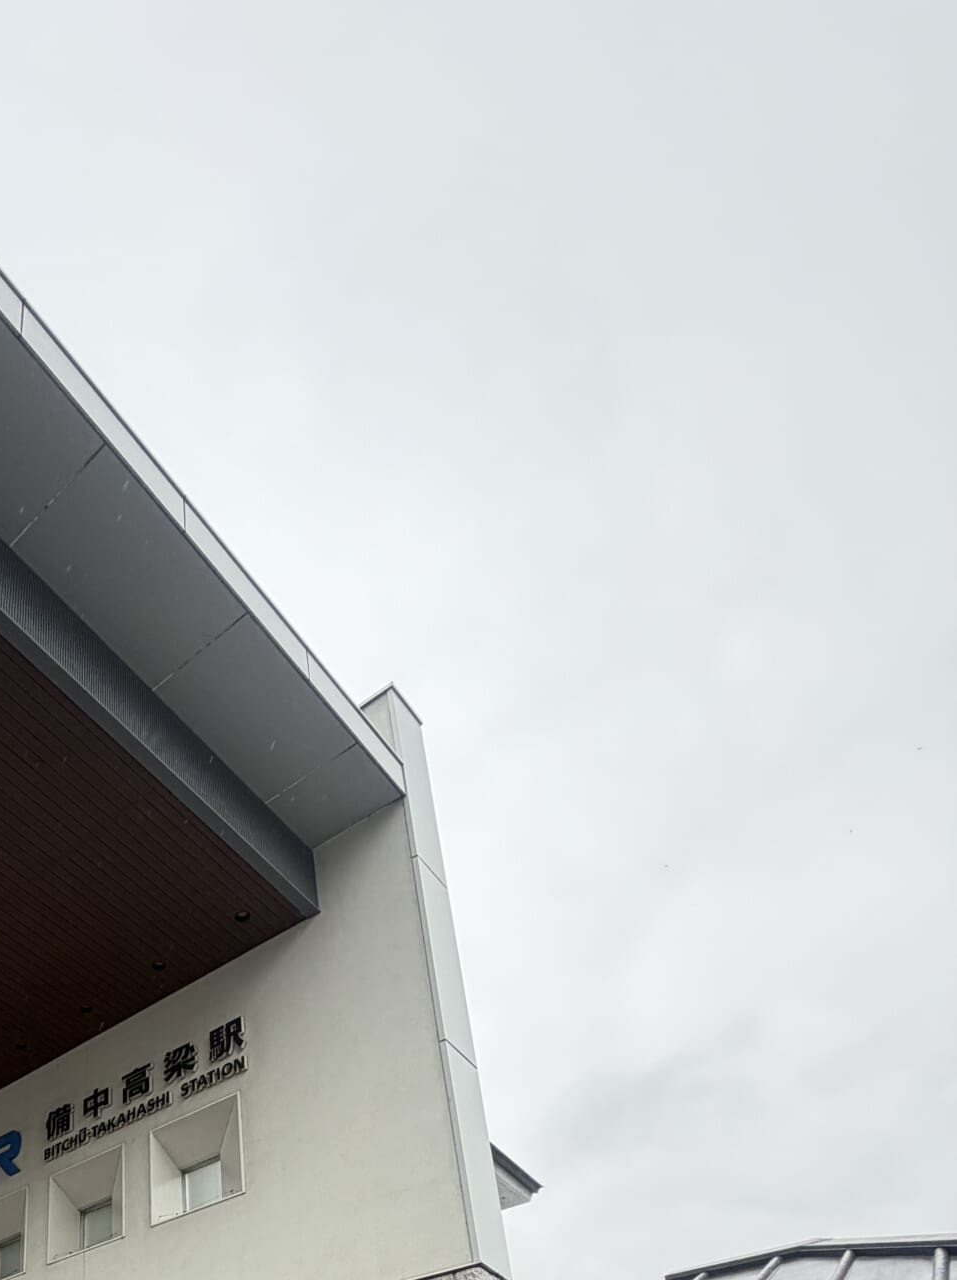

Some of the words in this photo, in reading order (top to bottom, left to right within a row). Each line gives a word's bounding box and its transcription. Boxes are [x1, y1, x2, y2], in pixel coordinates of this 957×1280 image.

[46, 1016, 244, 1140] 備中高梁駅
[180, 1056, 246, 1097] STATION
